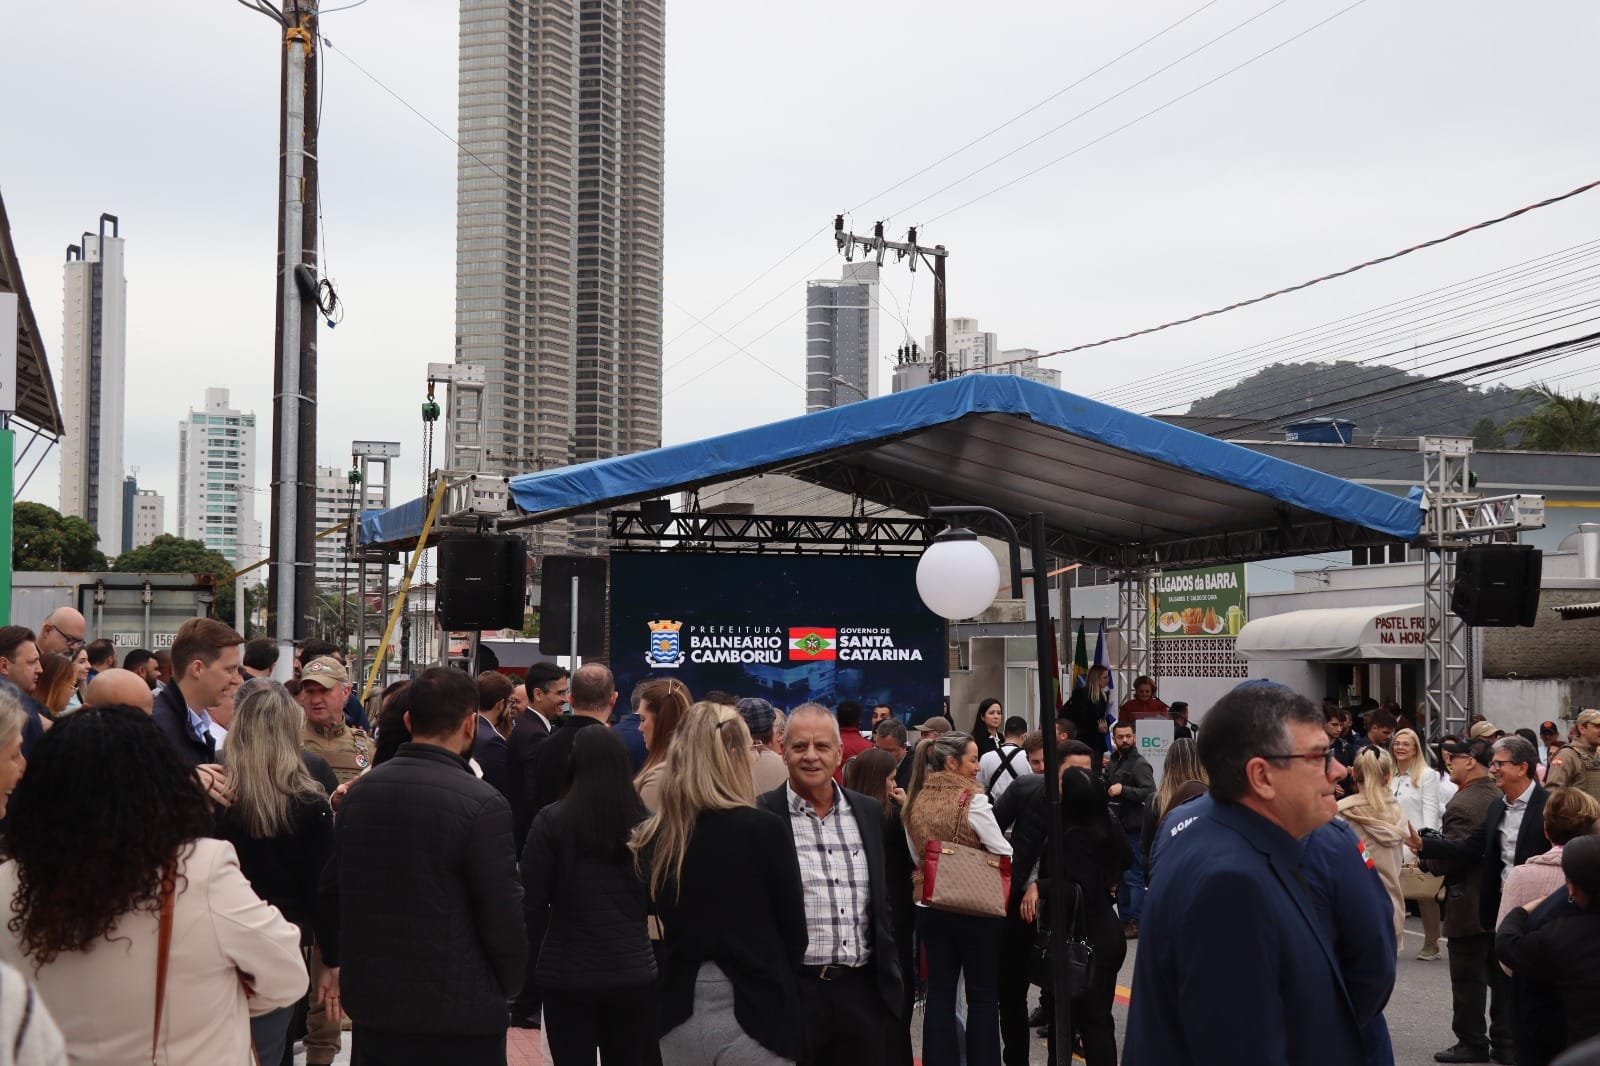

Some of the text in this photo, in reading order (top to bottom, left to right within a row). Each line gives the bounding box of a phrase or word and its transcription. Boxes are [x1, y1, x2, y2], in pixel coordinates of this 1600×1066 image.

[1149, 572, 1238, 592] SALGADOS da BARRA
[1375, 617, 1436, 629] PASTEL FRIO
[690, 625, 782, 634] PREFEITURA
[690, 635, 782, 648] BALNEÁRIO
[839, 636, 894, 648] SANTA
[1381, 632, 1426, 644] NA HORA
[690, 649, 782, 664] CAMBORIÚ
[839, 649, 923, 661] CATARINA
[1141, 737, 1161, 748] BC
